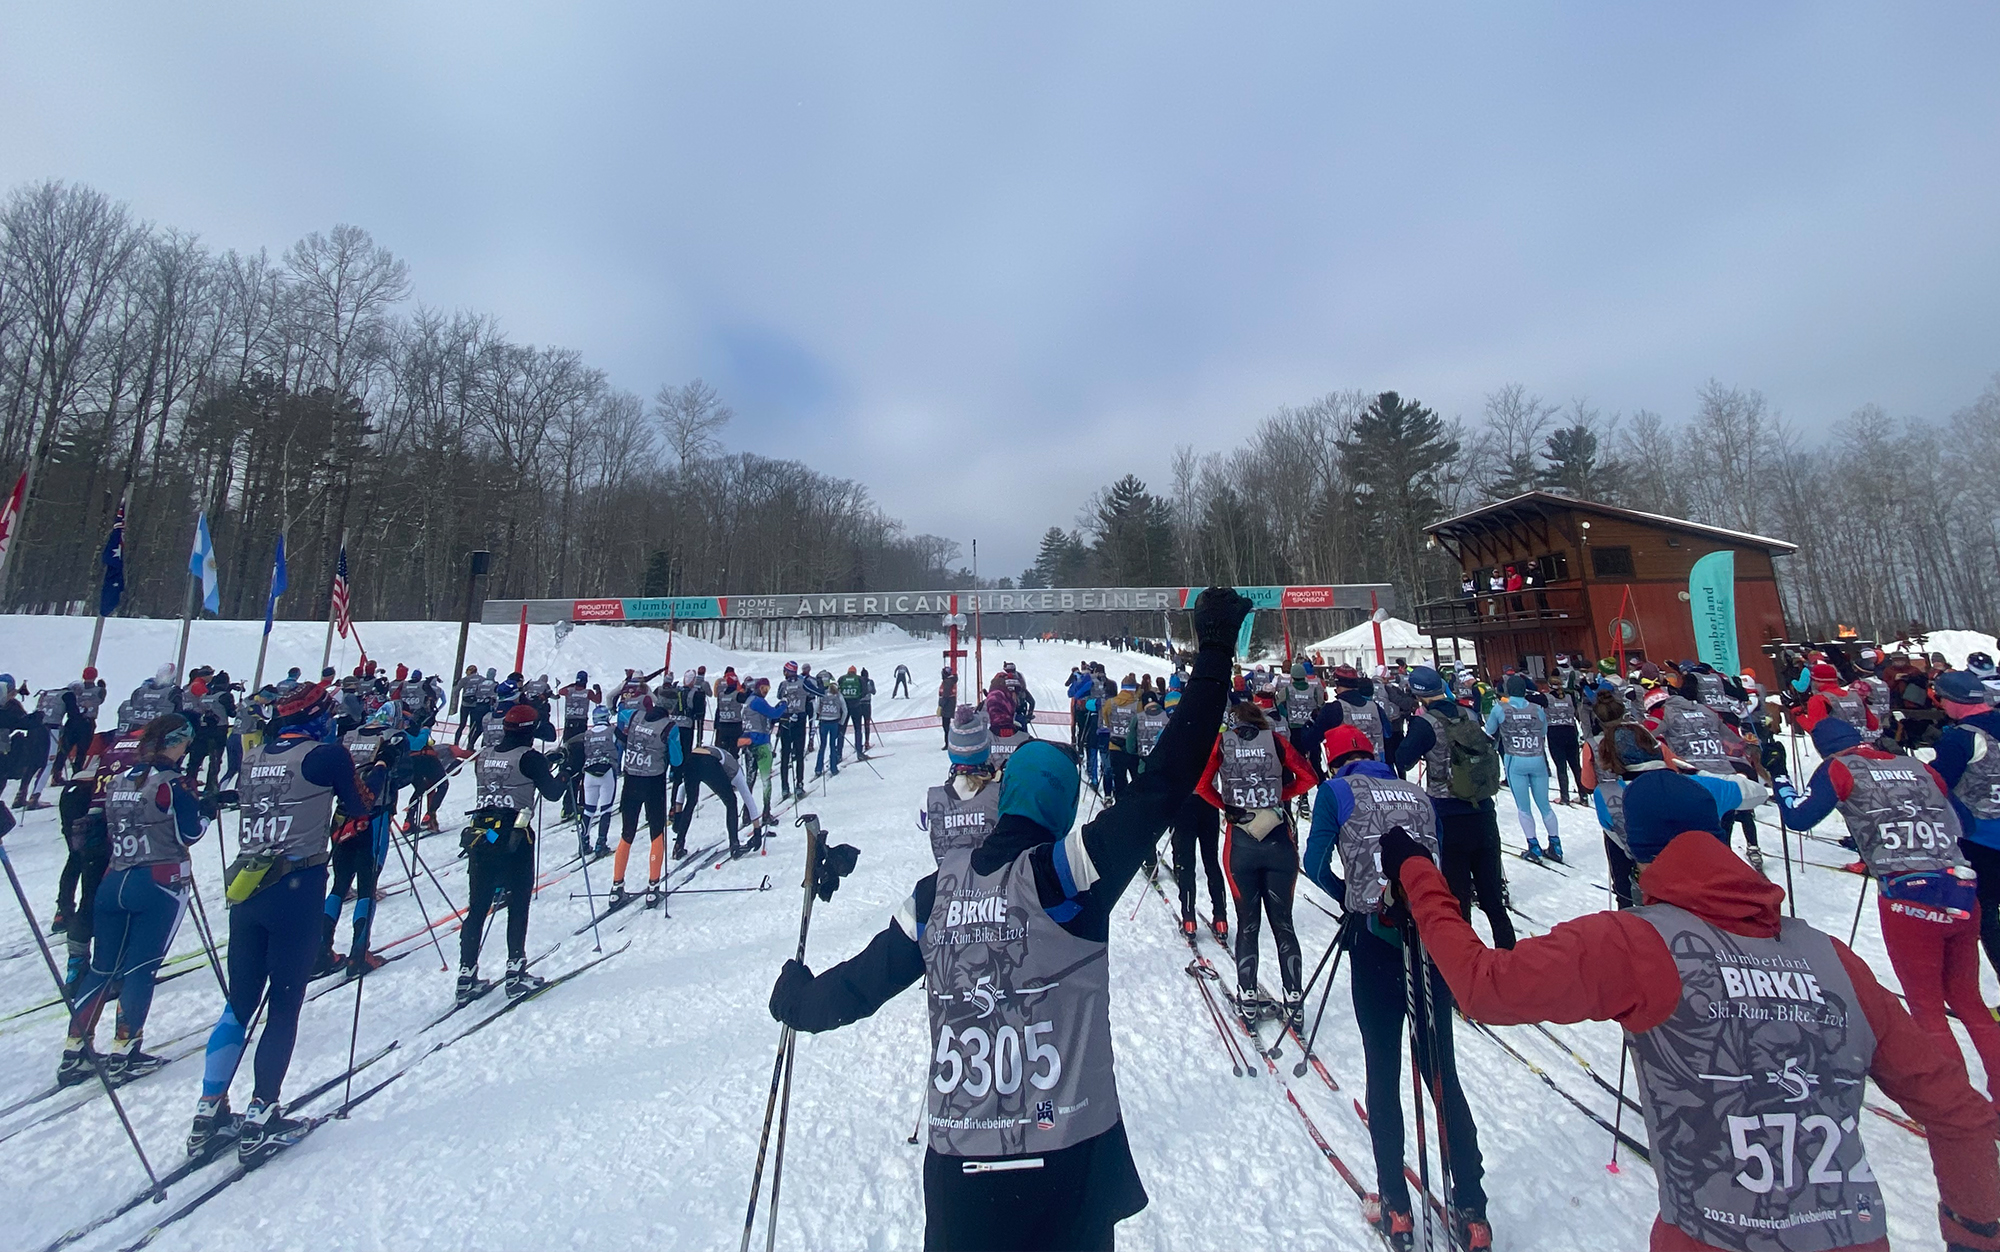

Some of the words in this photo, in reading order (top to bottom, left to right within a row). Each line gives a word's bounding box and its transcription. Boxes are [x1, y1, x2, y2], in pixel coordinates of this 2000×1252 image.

[577, 603, 600, 611] PROUD
[600, 603, 619, 611] TITLE
[738, 599, 776, 608] HOME
[738, 608, 754, 617] OF
[758, 607, 784, 616] THE
[798, 596, 952, 615] AMERICAN
[970, 592, 1171, 612] BIRKEBEINER
[1703, 587, 1724, 672] slumberland
[350, 743, 375, 751] BIRKIE
[1511, 736, 1539, 749] 5784
[625, 749, 652, 767] 5764
[1235, 748, 1266, 758] BIRKIE
[250, 765, 287, 779] BIRKIE
[484, 759, 509, 769] BIRKIE
[1870, 770, 1917, 781] BIRKIE
[112, 791, 142, 802] BIRKIE
[1233, 787, 1278, 808] 5434
[1370, 790, 1418, 804] BIRKIE
[944, 812, 986, 829] BIRKIE
[242, 815, 294, 844] 5417
[1878, 821, 1951, 850] 5795
[952, 884, 1008, 898] slumbeand
[946, 896, 1008, 928] BIRKIE
[1891, 903, 1953, 924] #VSALS
[950, 928, 974, 945] Run.
[975, 926, 997, 943] Bike.
[999, 920, 1030, 942] Live!
[1715, 950, 1811, 971] slumberland
[1720, 966, 1826, 1005] BIRKIE
[1708, 1001, 1734, 1019] Ski.
[1738, 1002, 1774, 1021] Run.
[1777, 1004, 1815, 1023] Bike.
[933, 1020, 1062, 1098] 5305
[1036, 1100, 1052, 1112] US
[1703, 1206, 1735, 1225] 2023
